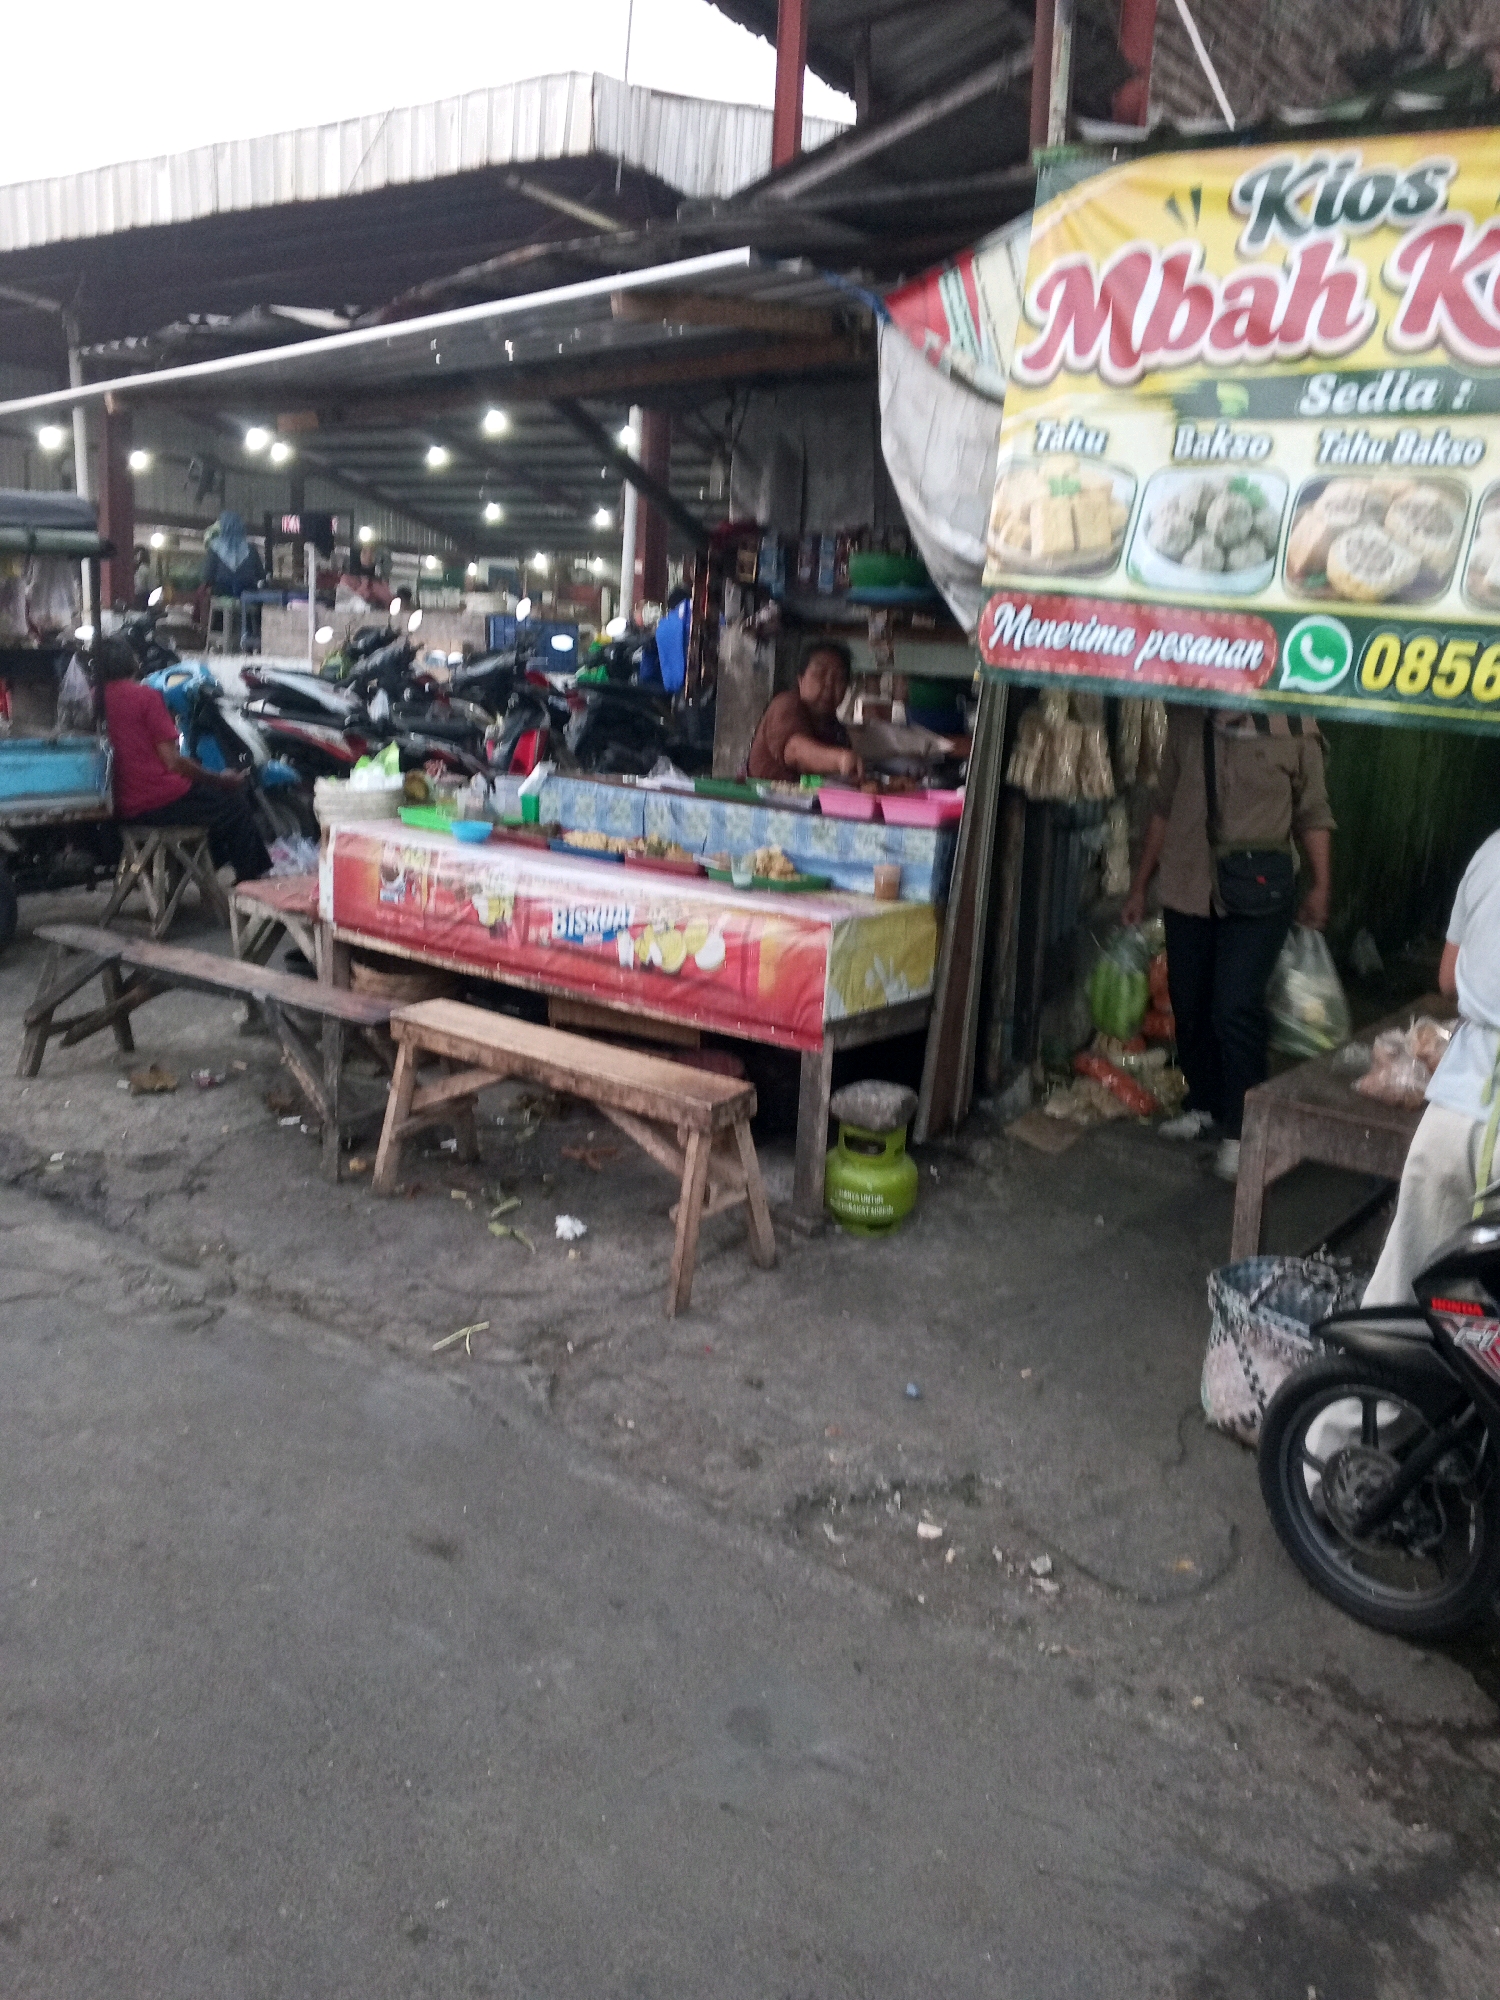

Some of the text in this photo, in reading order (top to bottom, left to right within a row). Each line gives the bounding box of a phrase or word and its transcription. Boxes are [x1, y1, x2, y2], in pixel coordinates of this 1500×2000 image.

[1234, 150, 1456, 250] Kios
[1016, 220, 1500, 374] Mbah K
[1299, 369, 1439, 416] Sedia
[1034, 418, 1108, 454] Tahu
[1172, 421, 1274, 462] Bakso
[1316, 425, 1487, 468] Tahu Bakso
[988, 601, 1264, 672] Menerima pesanan
[1361, 631, 1500, 703] 0856
